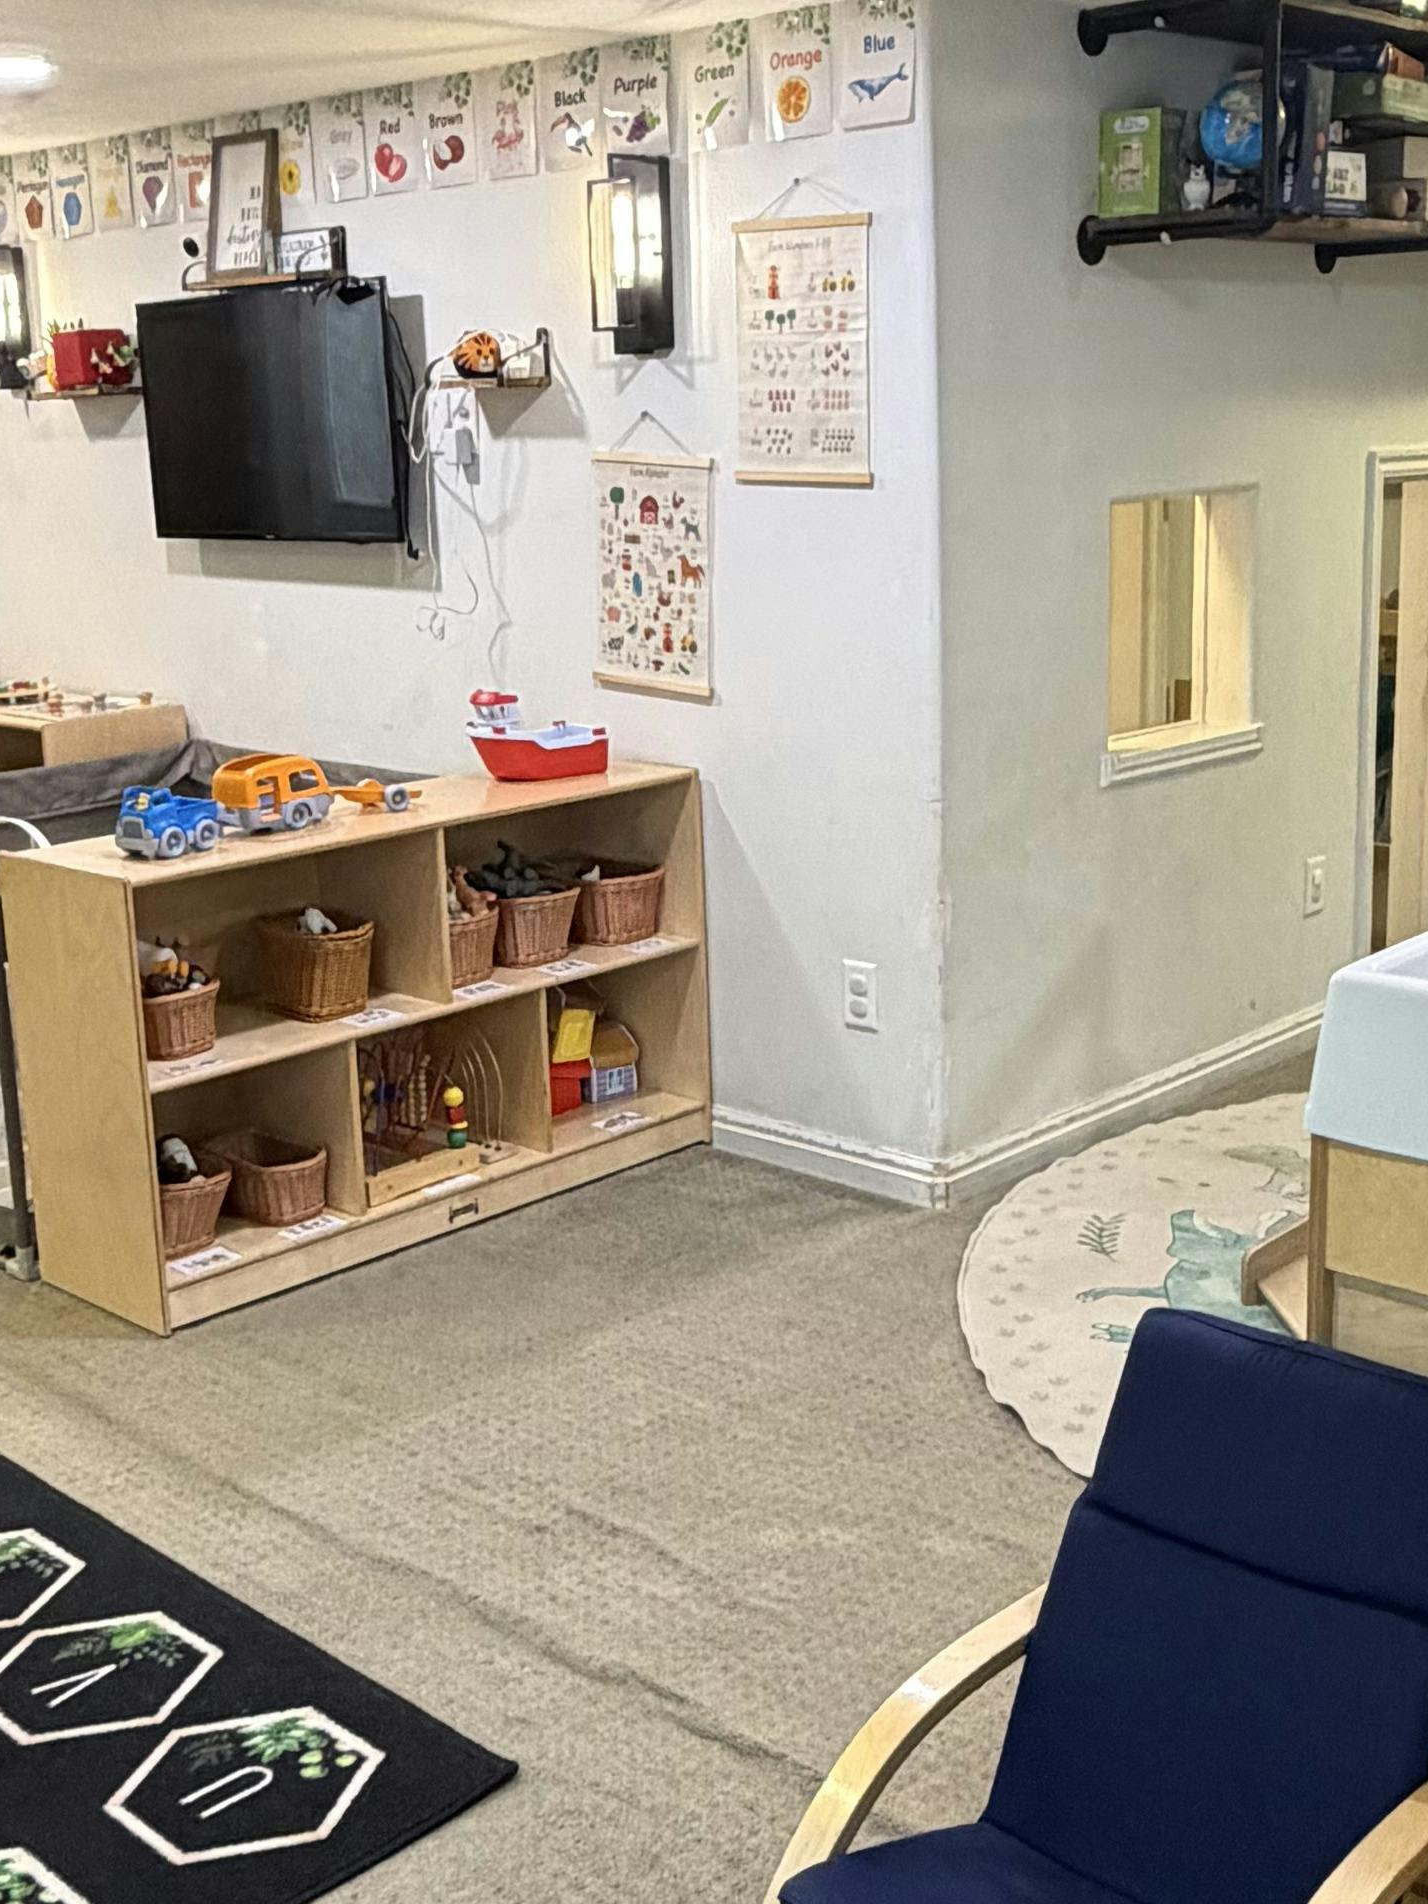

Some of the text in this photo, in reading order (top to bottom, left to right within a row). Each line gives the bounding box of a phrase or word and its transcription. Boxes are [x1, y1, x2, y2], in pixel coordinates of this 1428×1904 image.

[863, 34, 896, 55] Blue
[769, 48, 823, 72] Orange
[694, 63, 735, 84] Green
[613, 75, 658, 96] Purple
[554, 89, 586, 108] Black
[379, 118, 401, 135] Red
[428, 111, 464, 129] Brown
